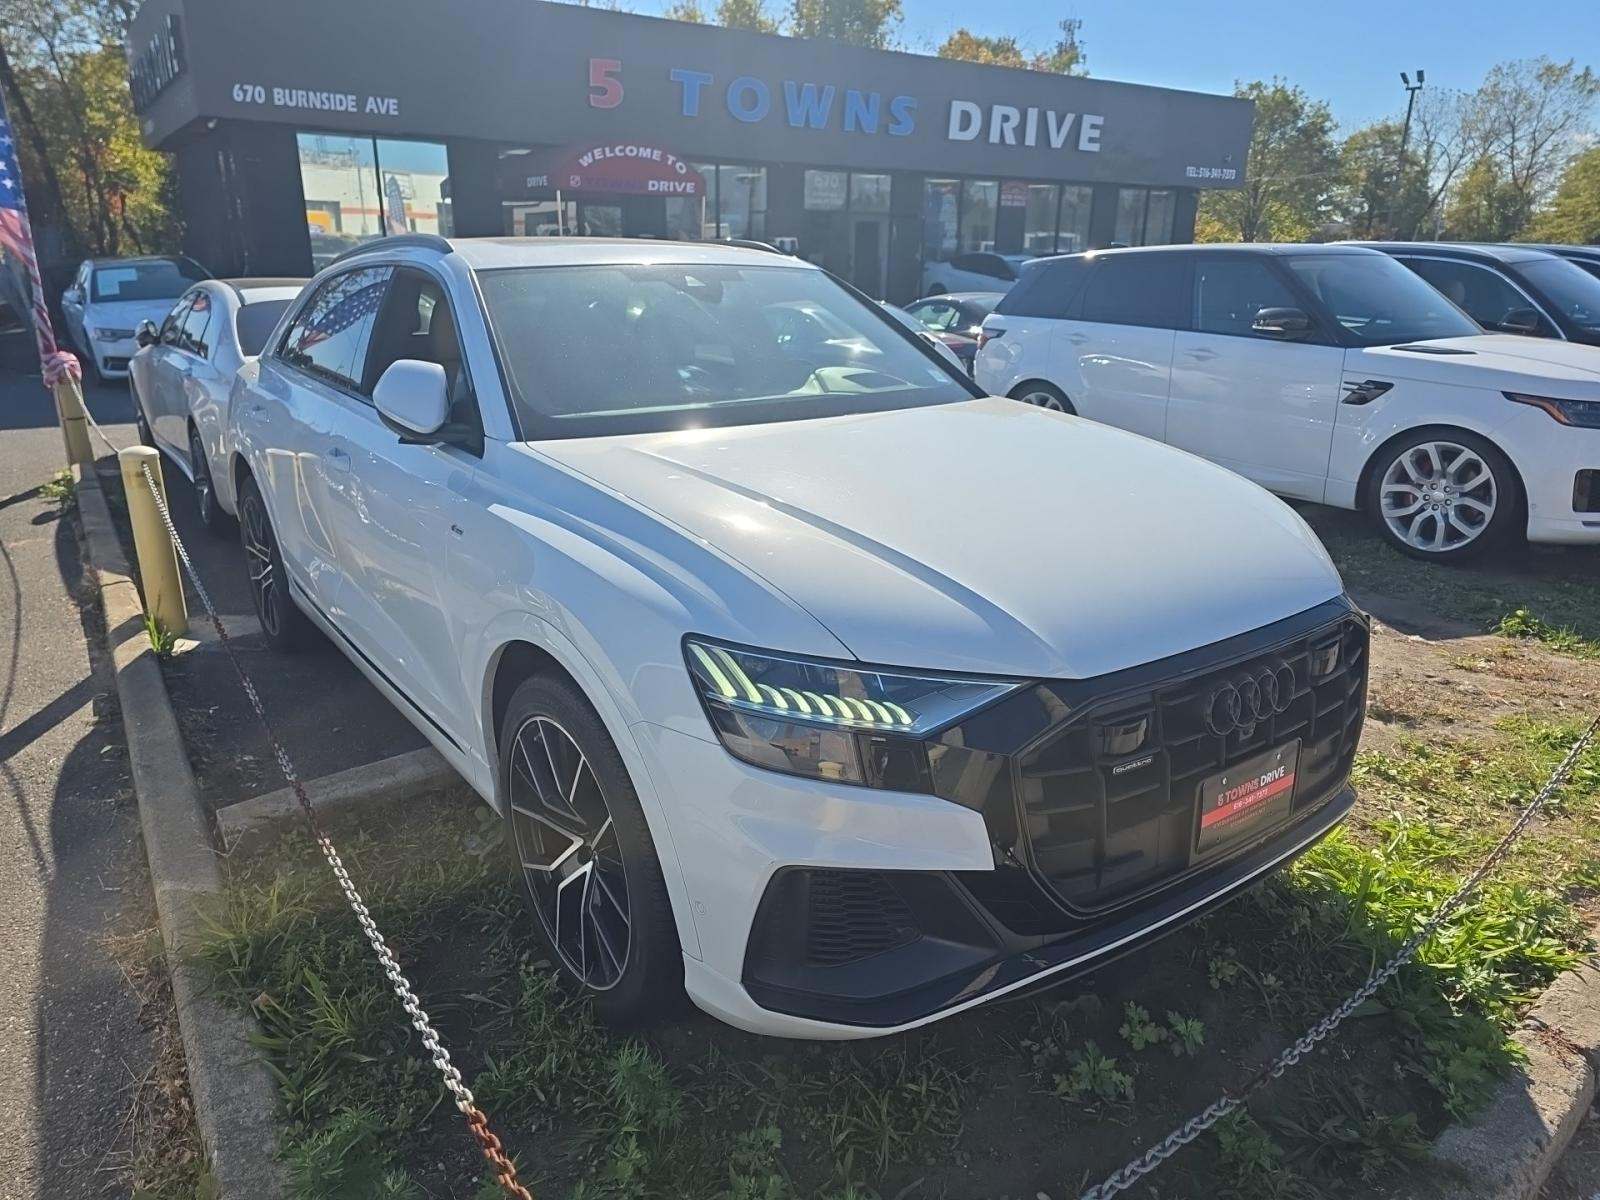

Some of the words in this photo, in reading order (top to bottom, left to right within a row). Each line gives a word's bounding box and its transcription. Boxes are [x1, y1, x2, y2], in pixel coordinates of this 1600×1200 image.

[232, 84, 266, 104] 670
[272, 87, 358, 112] BURNSIDE
[365, 96, 399, 115] AVE
[589, 58, 624, 109] 5
[670, 68, 919, 136] TOWNS
[948, 100, 1104, 152] DRIVE
[578, 145, 661, 168] WELCOME
[666, 155, 687, 174] TO
[526, 175, 548, 188] DRIVE
[647, 180, 696, 194] DRIVE
[1225, 778, 1260, 803] TOWNS
[1260, 765, 1285, 787] DRIVE
